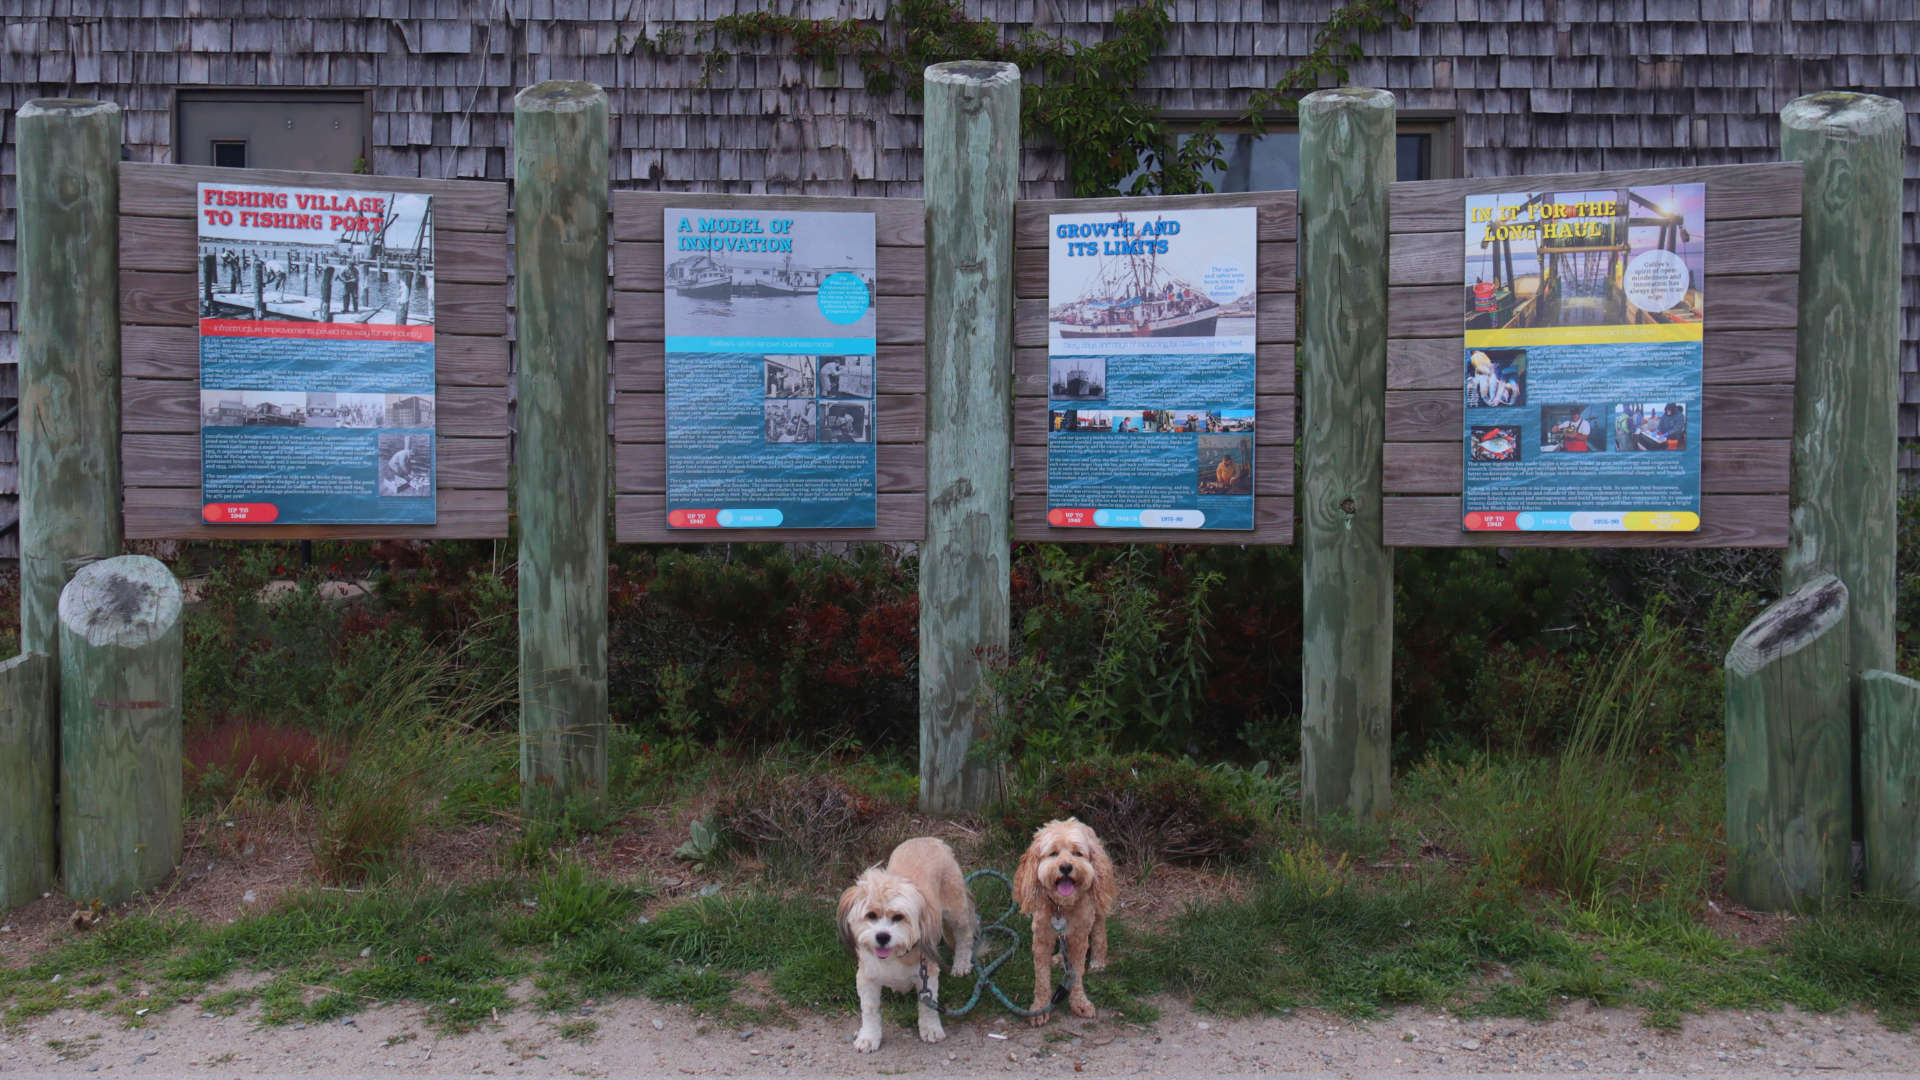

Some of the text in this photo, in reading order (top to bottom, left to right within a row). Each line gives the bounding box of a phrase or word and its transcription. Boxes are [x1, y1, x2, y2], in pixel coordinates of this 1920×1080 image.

[204, 190, 384, 213] FISHING VILLAGE
[204, 210, 384, 233] TO FISHING PORT
[1471, 201, 1616, 223] IN IT FOR THE
[678, 217, 793, 234] A MODEL OF
[1056, 220, 1181, 239] GROWTH AND
[1484, 221, 1601, 241] LONG HAUL
[678, 236, 793, 253] INNOVATION
[1067, 240, 1169, 257] ITS LIMITS
